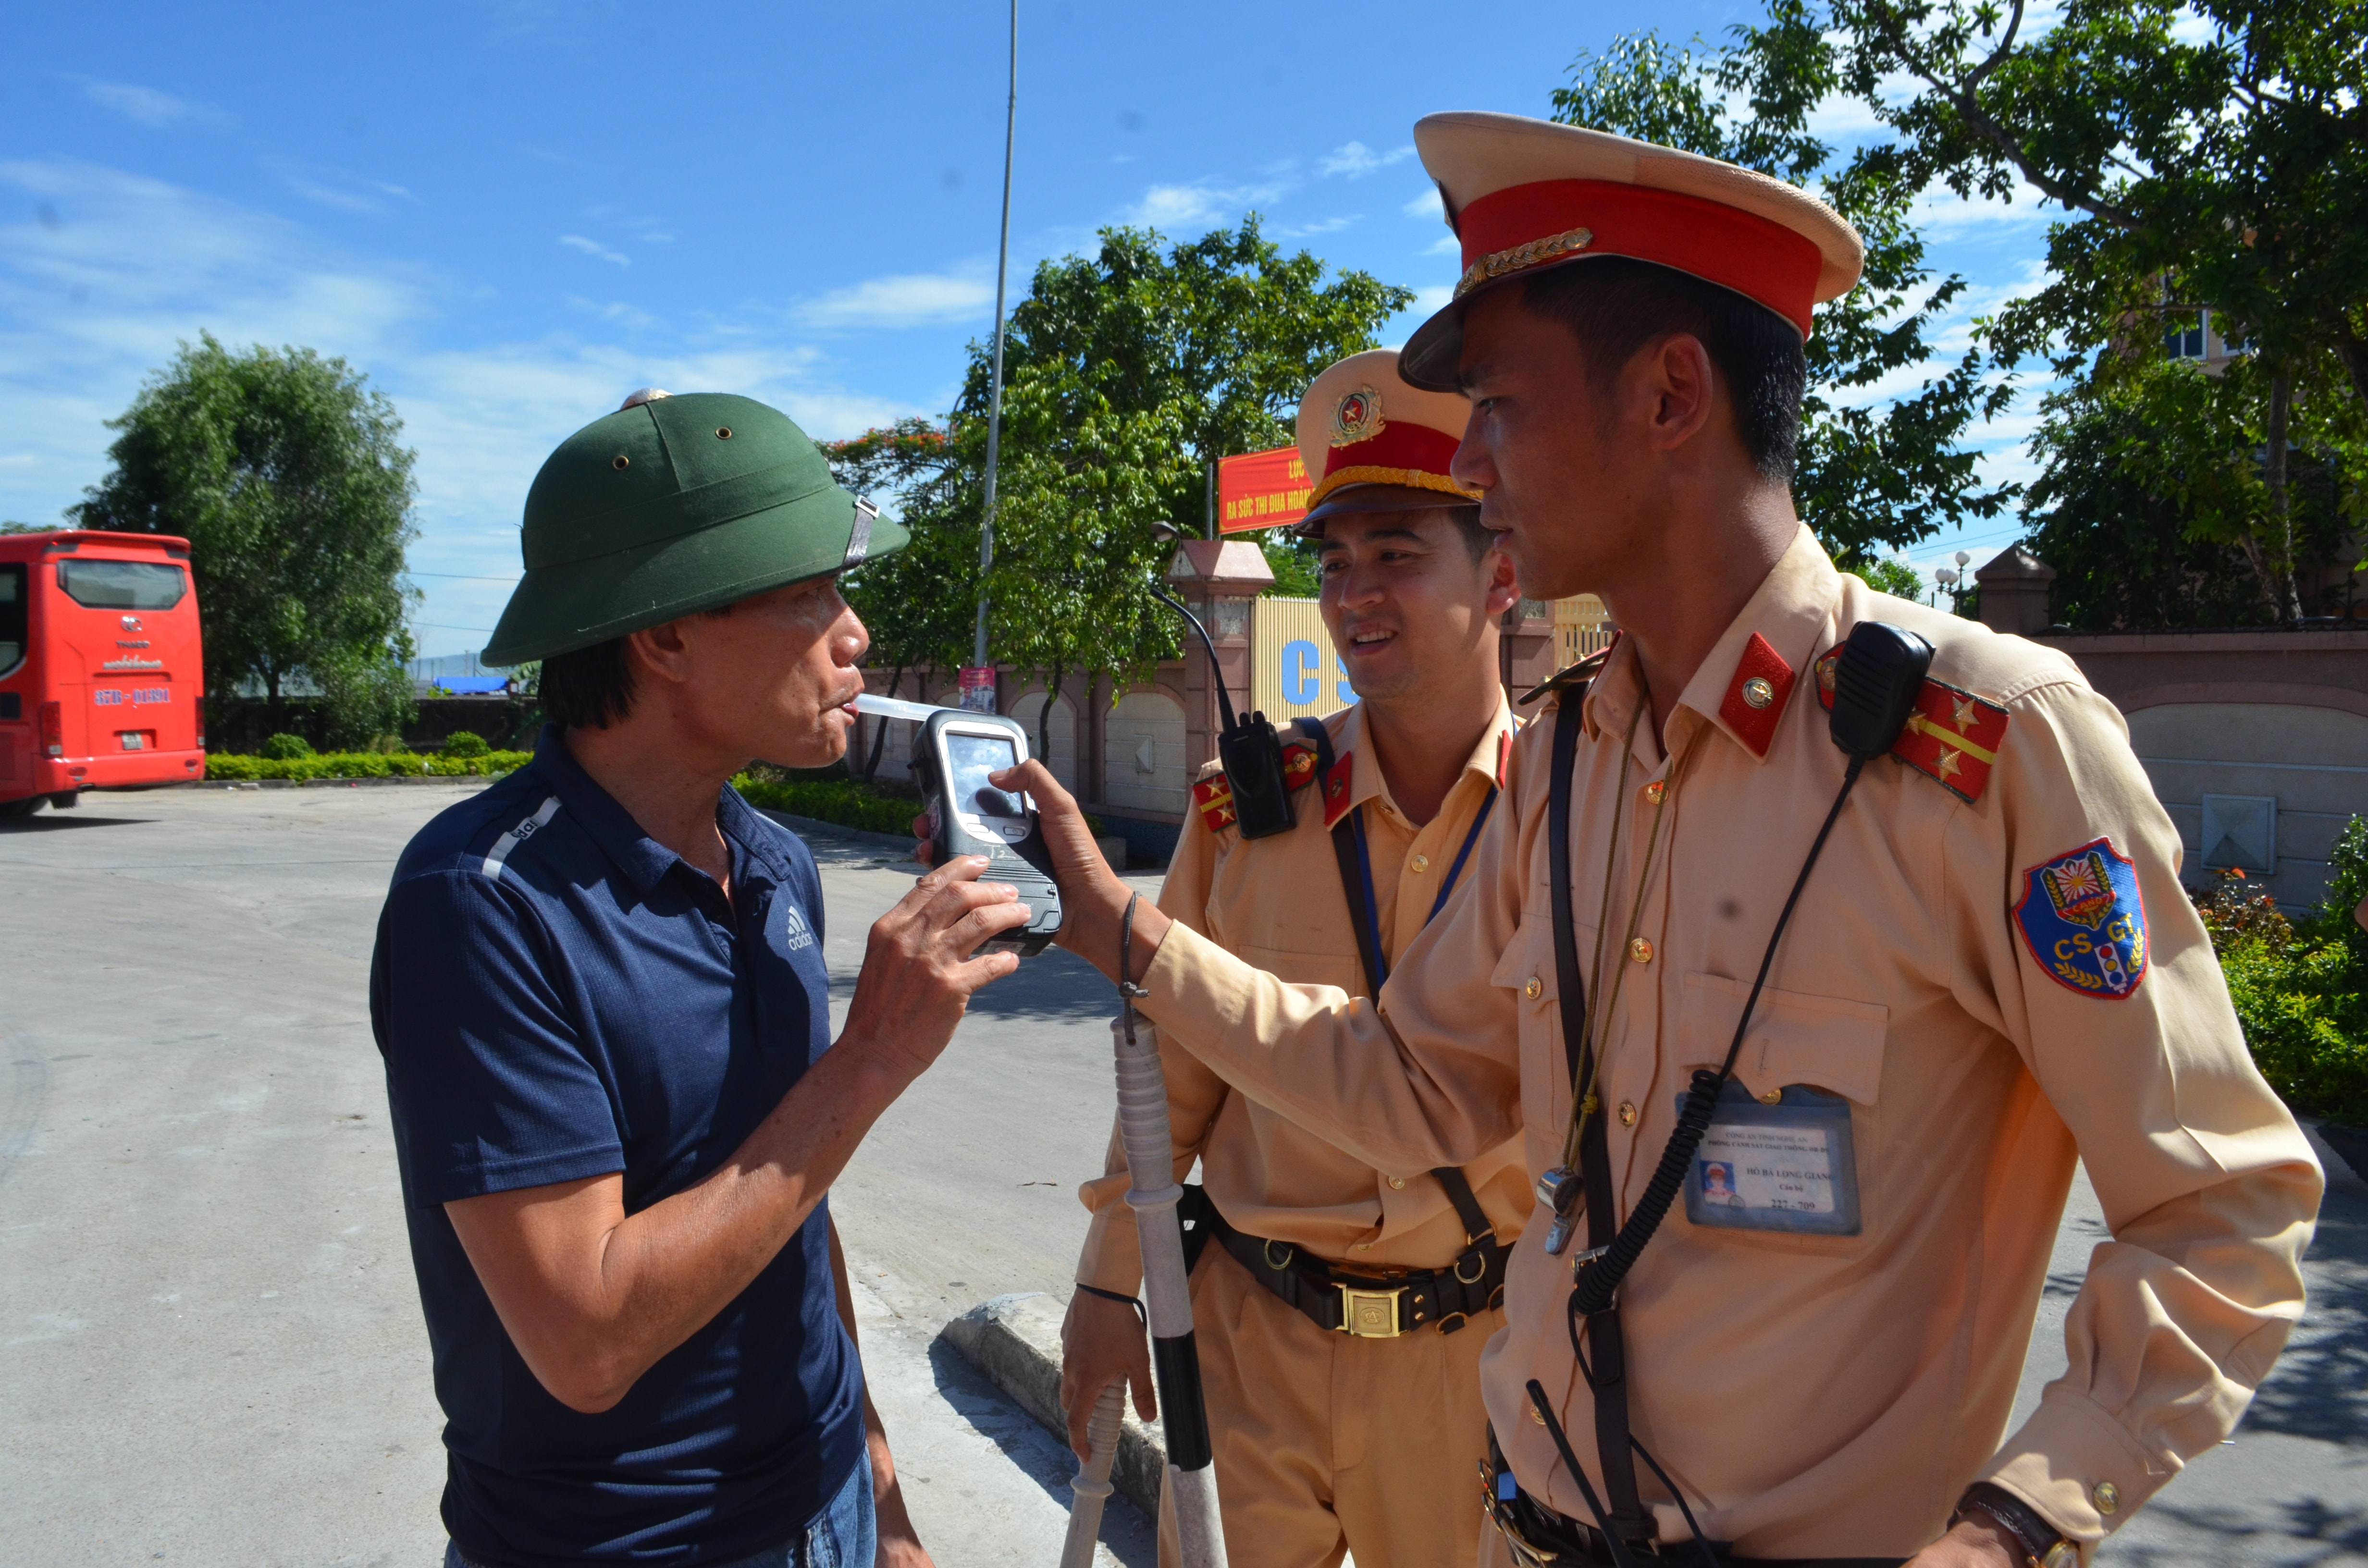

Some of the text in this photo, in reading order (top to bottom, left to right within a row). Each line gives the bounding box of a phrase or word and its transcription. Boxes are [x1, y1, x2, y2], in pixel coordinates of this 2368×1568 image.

[1227, 501, 1237, 520] RA
[1238, 493, 1254, 518] SỨC
[1255, 495, 1267, 515] THI
[1269, 492, 1286, 514] ĐUA
[788, 931, 813, 951] adidas
[1776, 1170, 1802, 1178] LONG
[1771, 1199, 1788, 1209] 227
